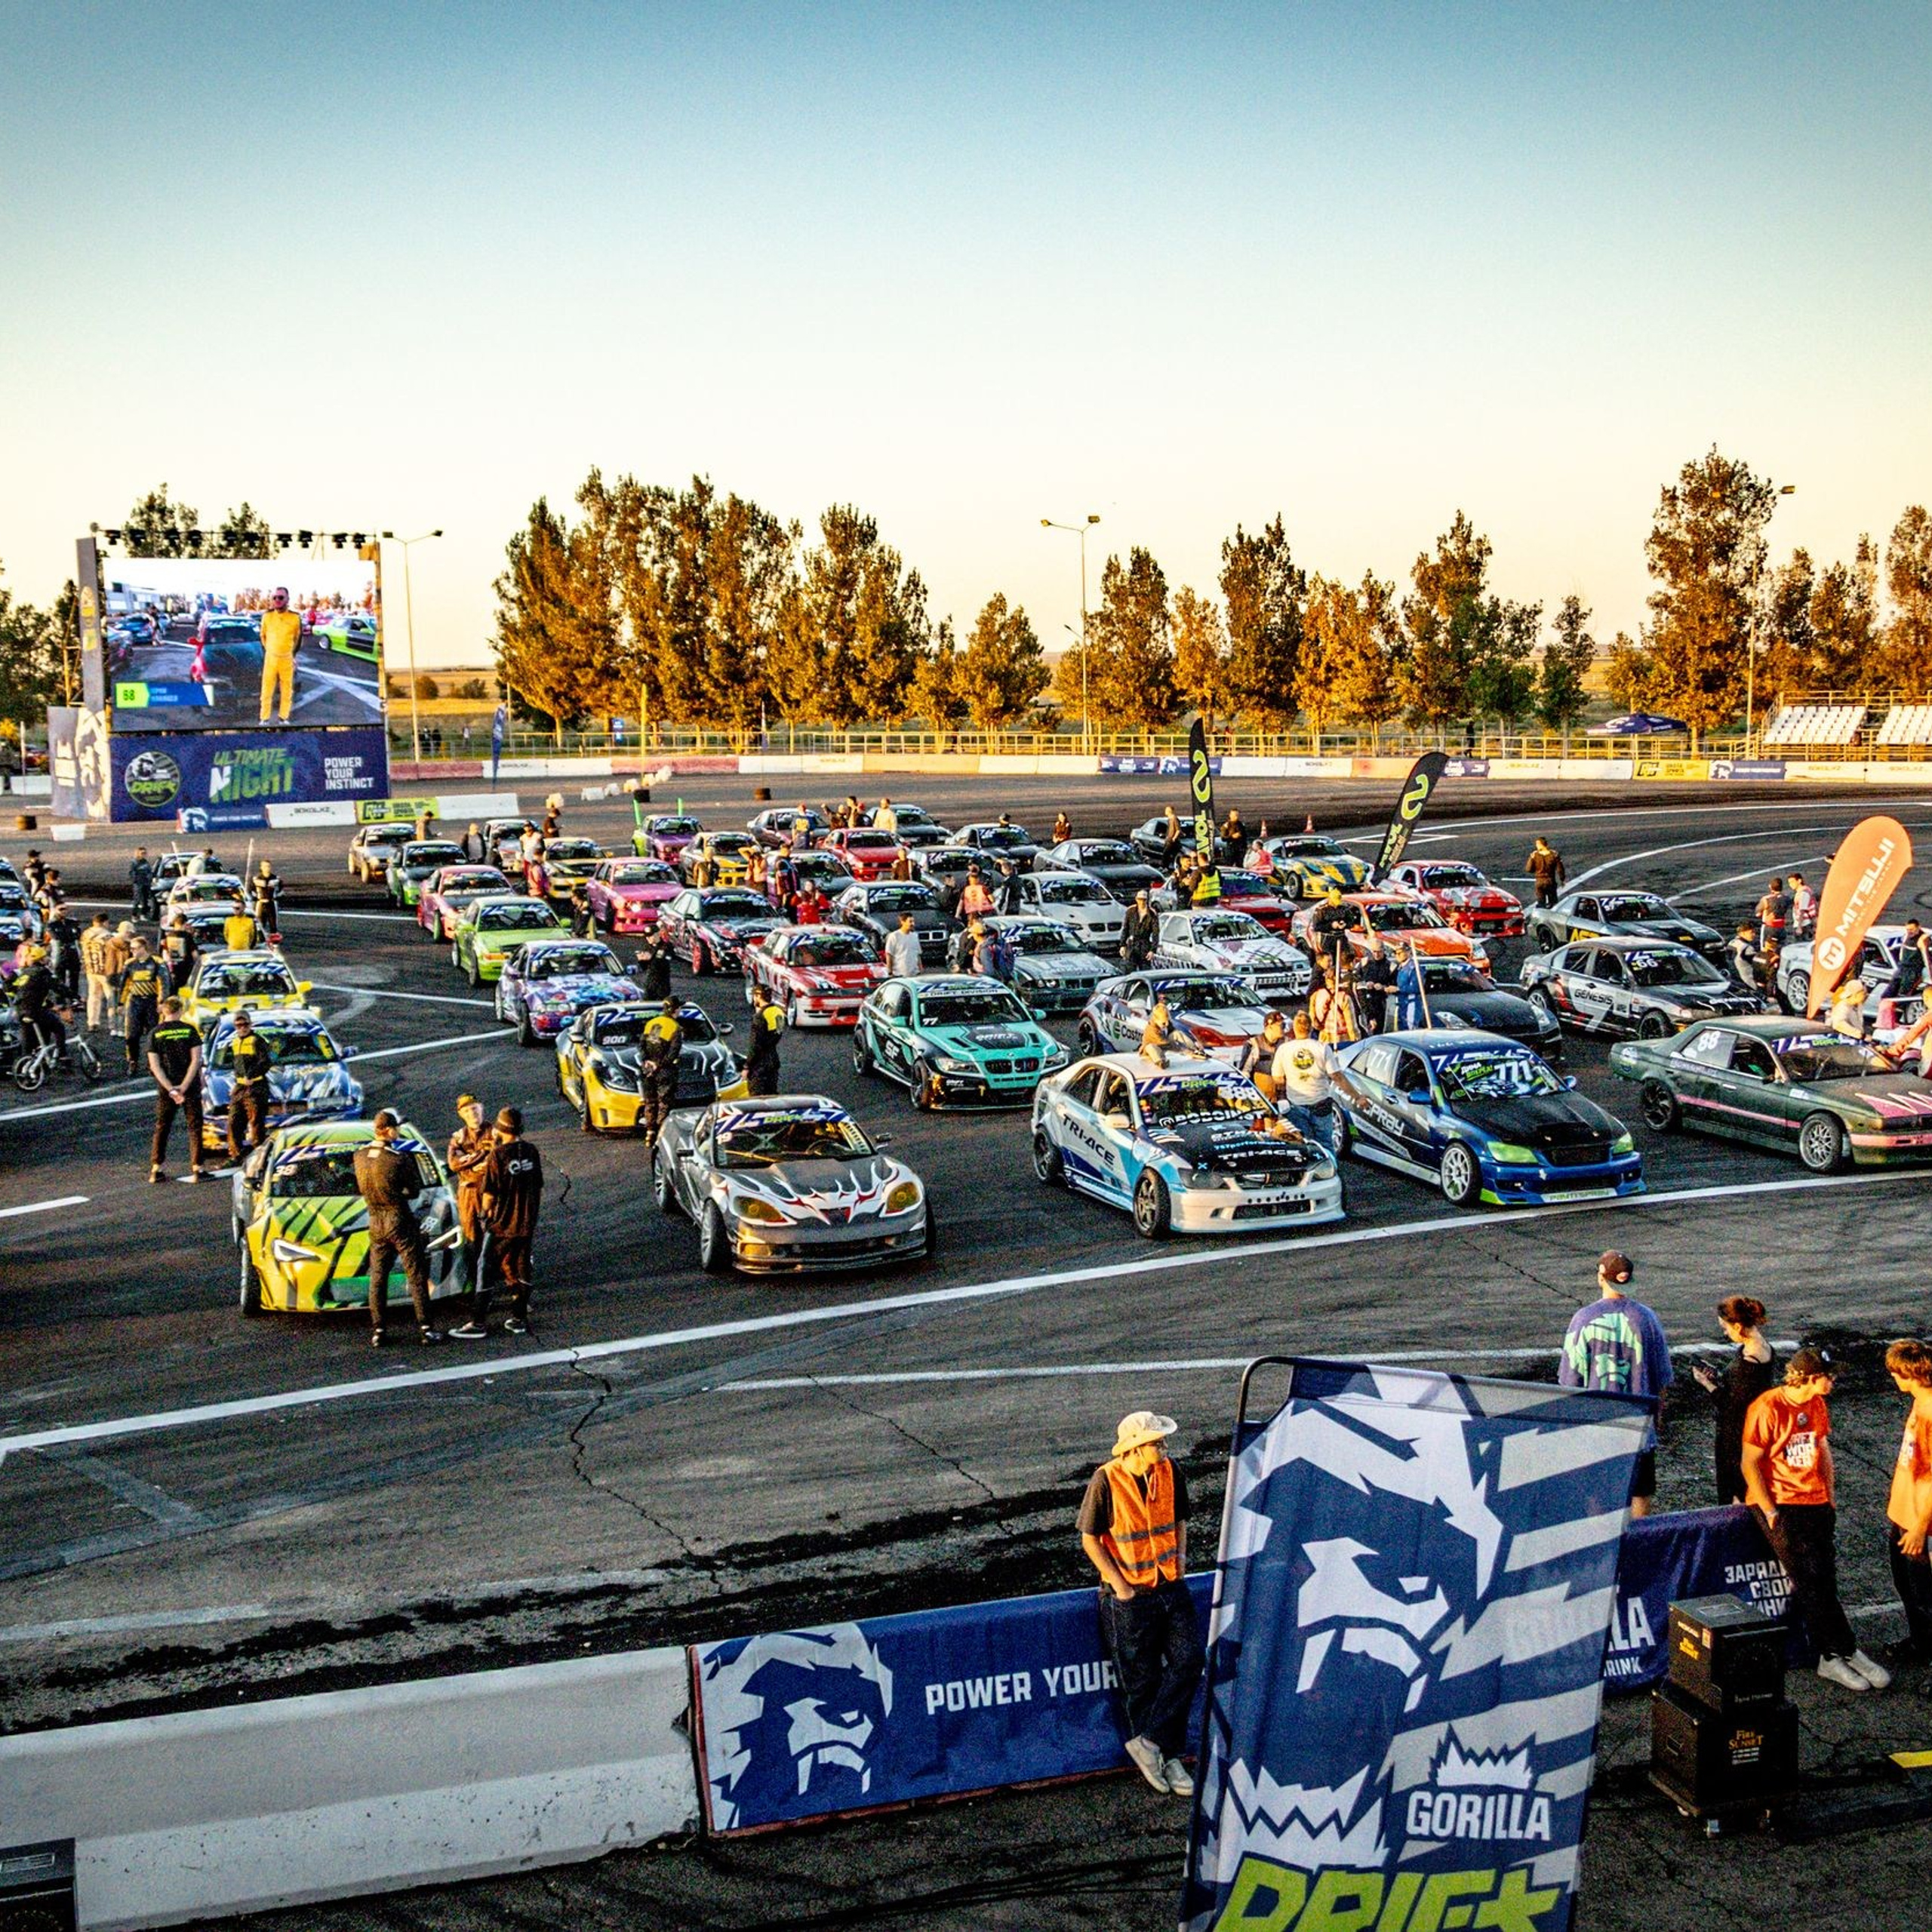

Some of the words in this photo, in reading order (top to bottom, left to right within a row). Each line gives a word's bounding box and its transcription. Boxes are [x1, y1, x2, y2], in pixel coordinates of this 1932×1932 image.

[214, 748, 286, 765] ULTIMATE
[324, 757, 362, 768] POWER
[209, 756, 296, 804] NIGHT
[325, 768, 353, 779] YOUR
[325, 777, 374, 789] INSTINCT
[1835, 837, 1897, 937] MITSUJI
[1574, 989, 1613, 1004] GENESIS
[1121, 1025, 1143, 1042] Castr
[1697, 1031, 1721, 1051] 88
[1371, 1048, 1392, 1070] 771
[1494, 1060, 1534, 1082] 771
[1063, 1114, 1115, 1166] TRI-ACE
[1604, 1657, 1644, 1677] RINK
[926, 1672, 1032, 1715] POWER
[1041, 1660, 1121, 1699] YOUR
[1406, 1791, 1552, 1841] GORILLA
[1214, 1857, 1561, 1932] DRIFT
